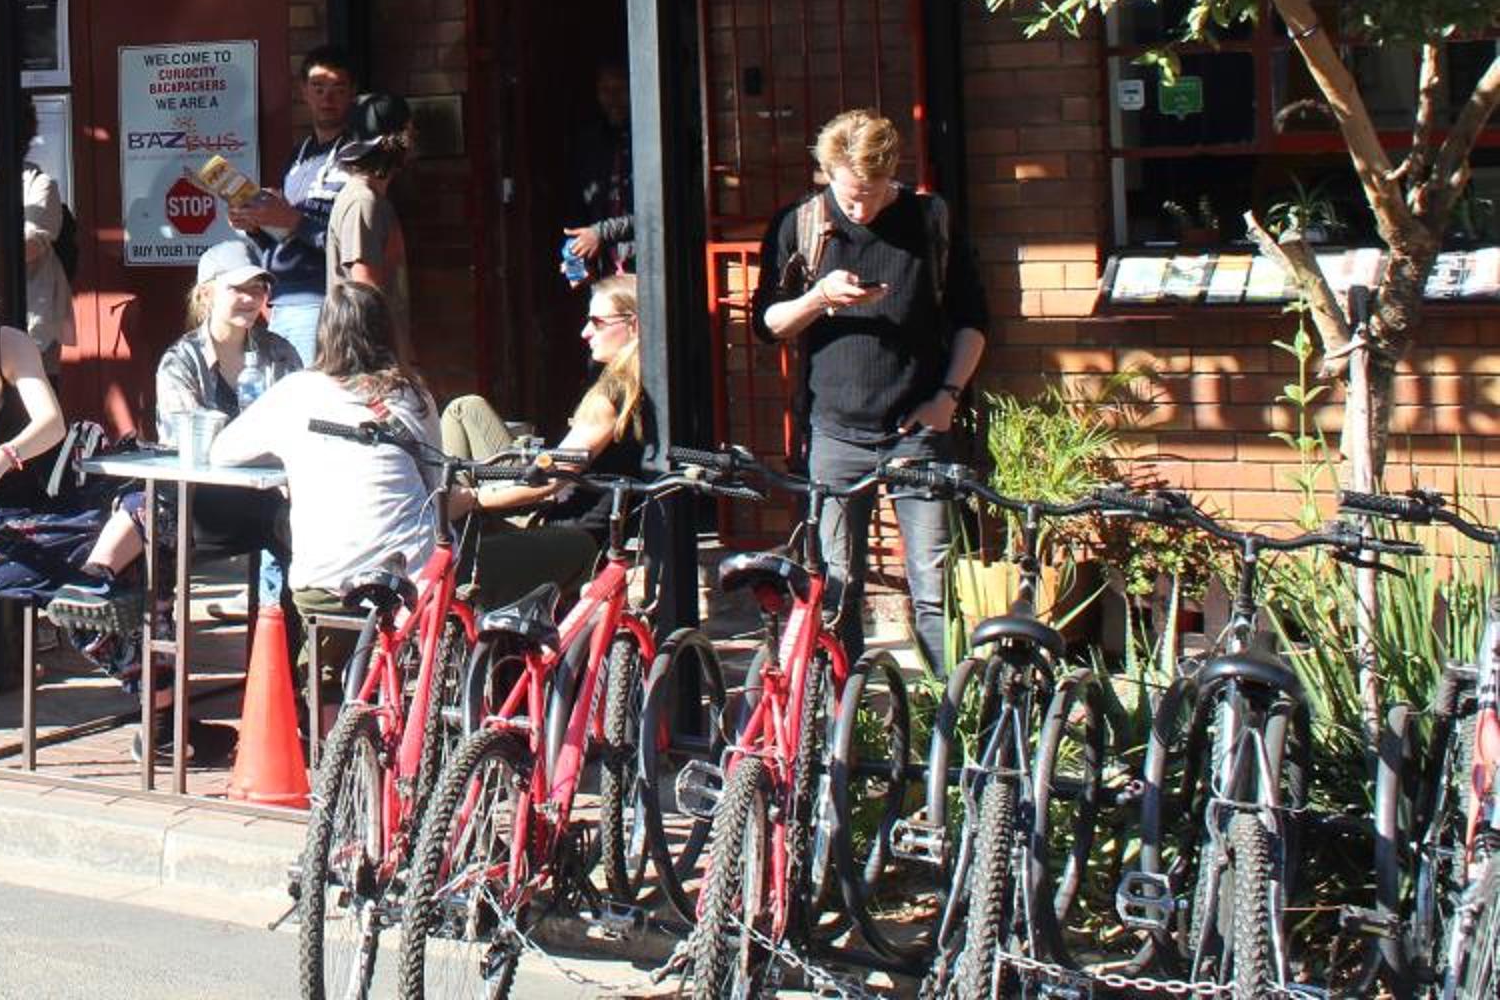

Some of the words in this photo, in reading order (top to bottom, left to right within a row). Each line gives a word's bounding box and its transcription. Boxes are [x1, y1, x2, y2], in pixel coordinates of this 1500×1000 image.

[144, 52, 210, 67] WELCOME
[214, 50, 232, 63] TO
[158, 66, 217, 80] CURIOCITY
[149, 80, 227, 94] BACKPACKERS
[155, 98, 177, 110] WE
[179, 97, 207, 109] ARE
[208, 95, 219, 108] A
[169, 196, 214, 217] STOP
[132, 244, 153, 257] BUY
[156, 244, 182, 257] YOUR
